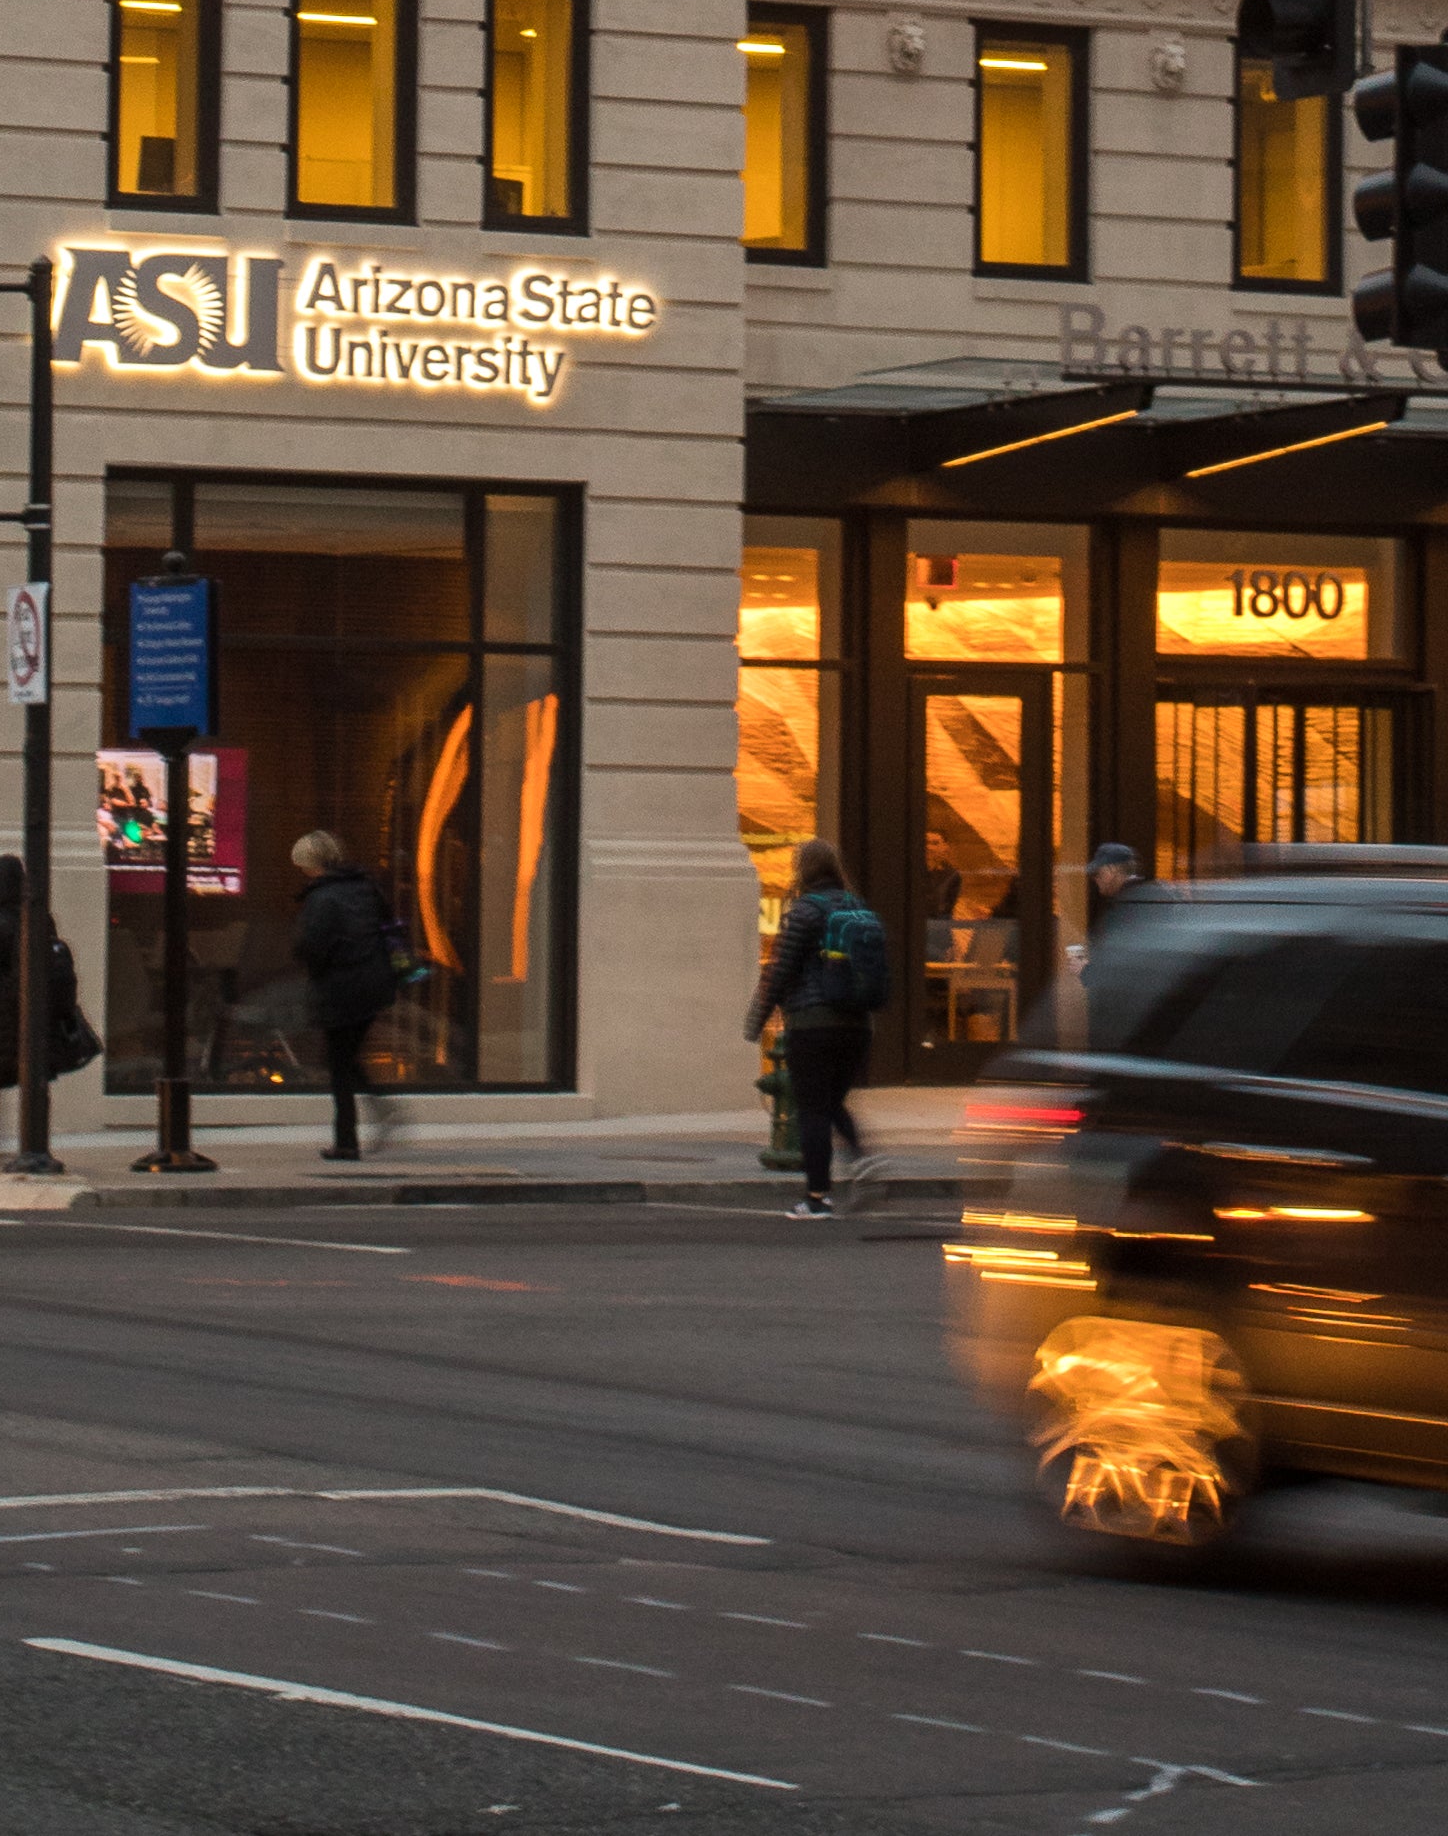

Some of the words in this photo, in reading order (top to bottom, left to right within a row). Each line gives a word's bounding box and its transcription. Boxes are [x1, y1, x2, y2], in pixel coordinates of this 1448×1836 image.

[51, 248, 284, 373] ASU
[305, 261, 509, 322] Arizona
[520, 273, 656, 329] State
[305, 326, 564, 398] University
[1060, 302, 1313, 380] Barrett
[1225, 568, 1345, 620] 1800
